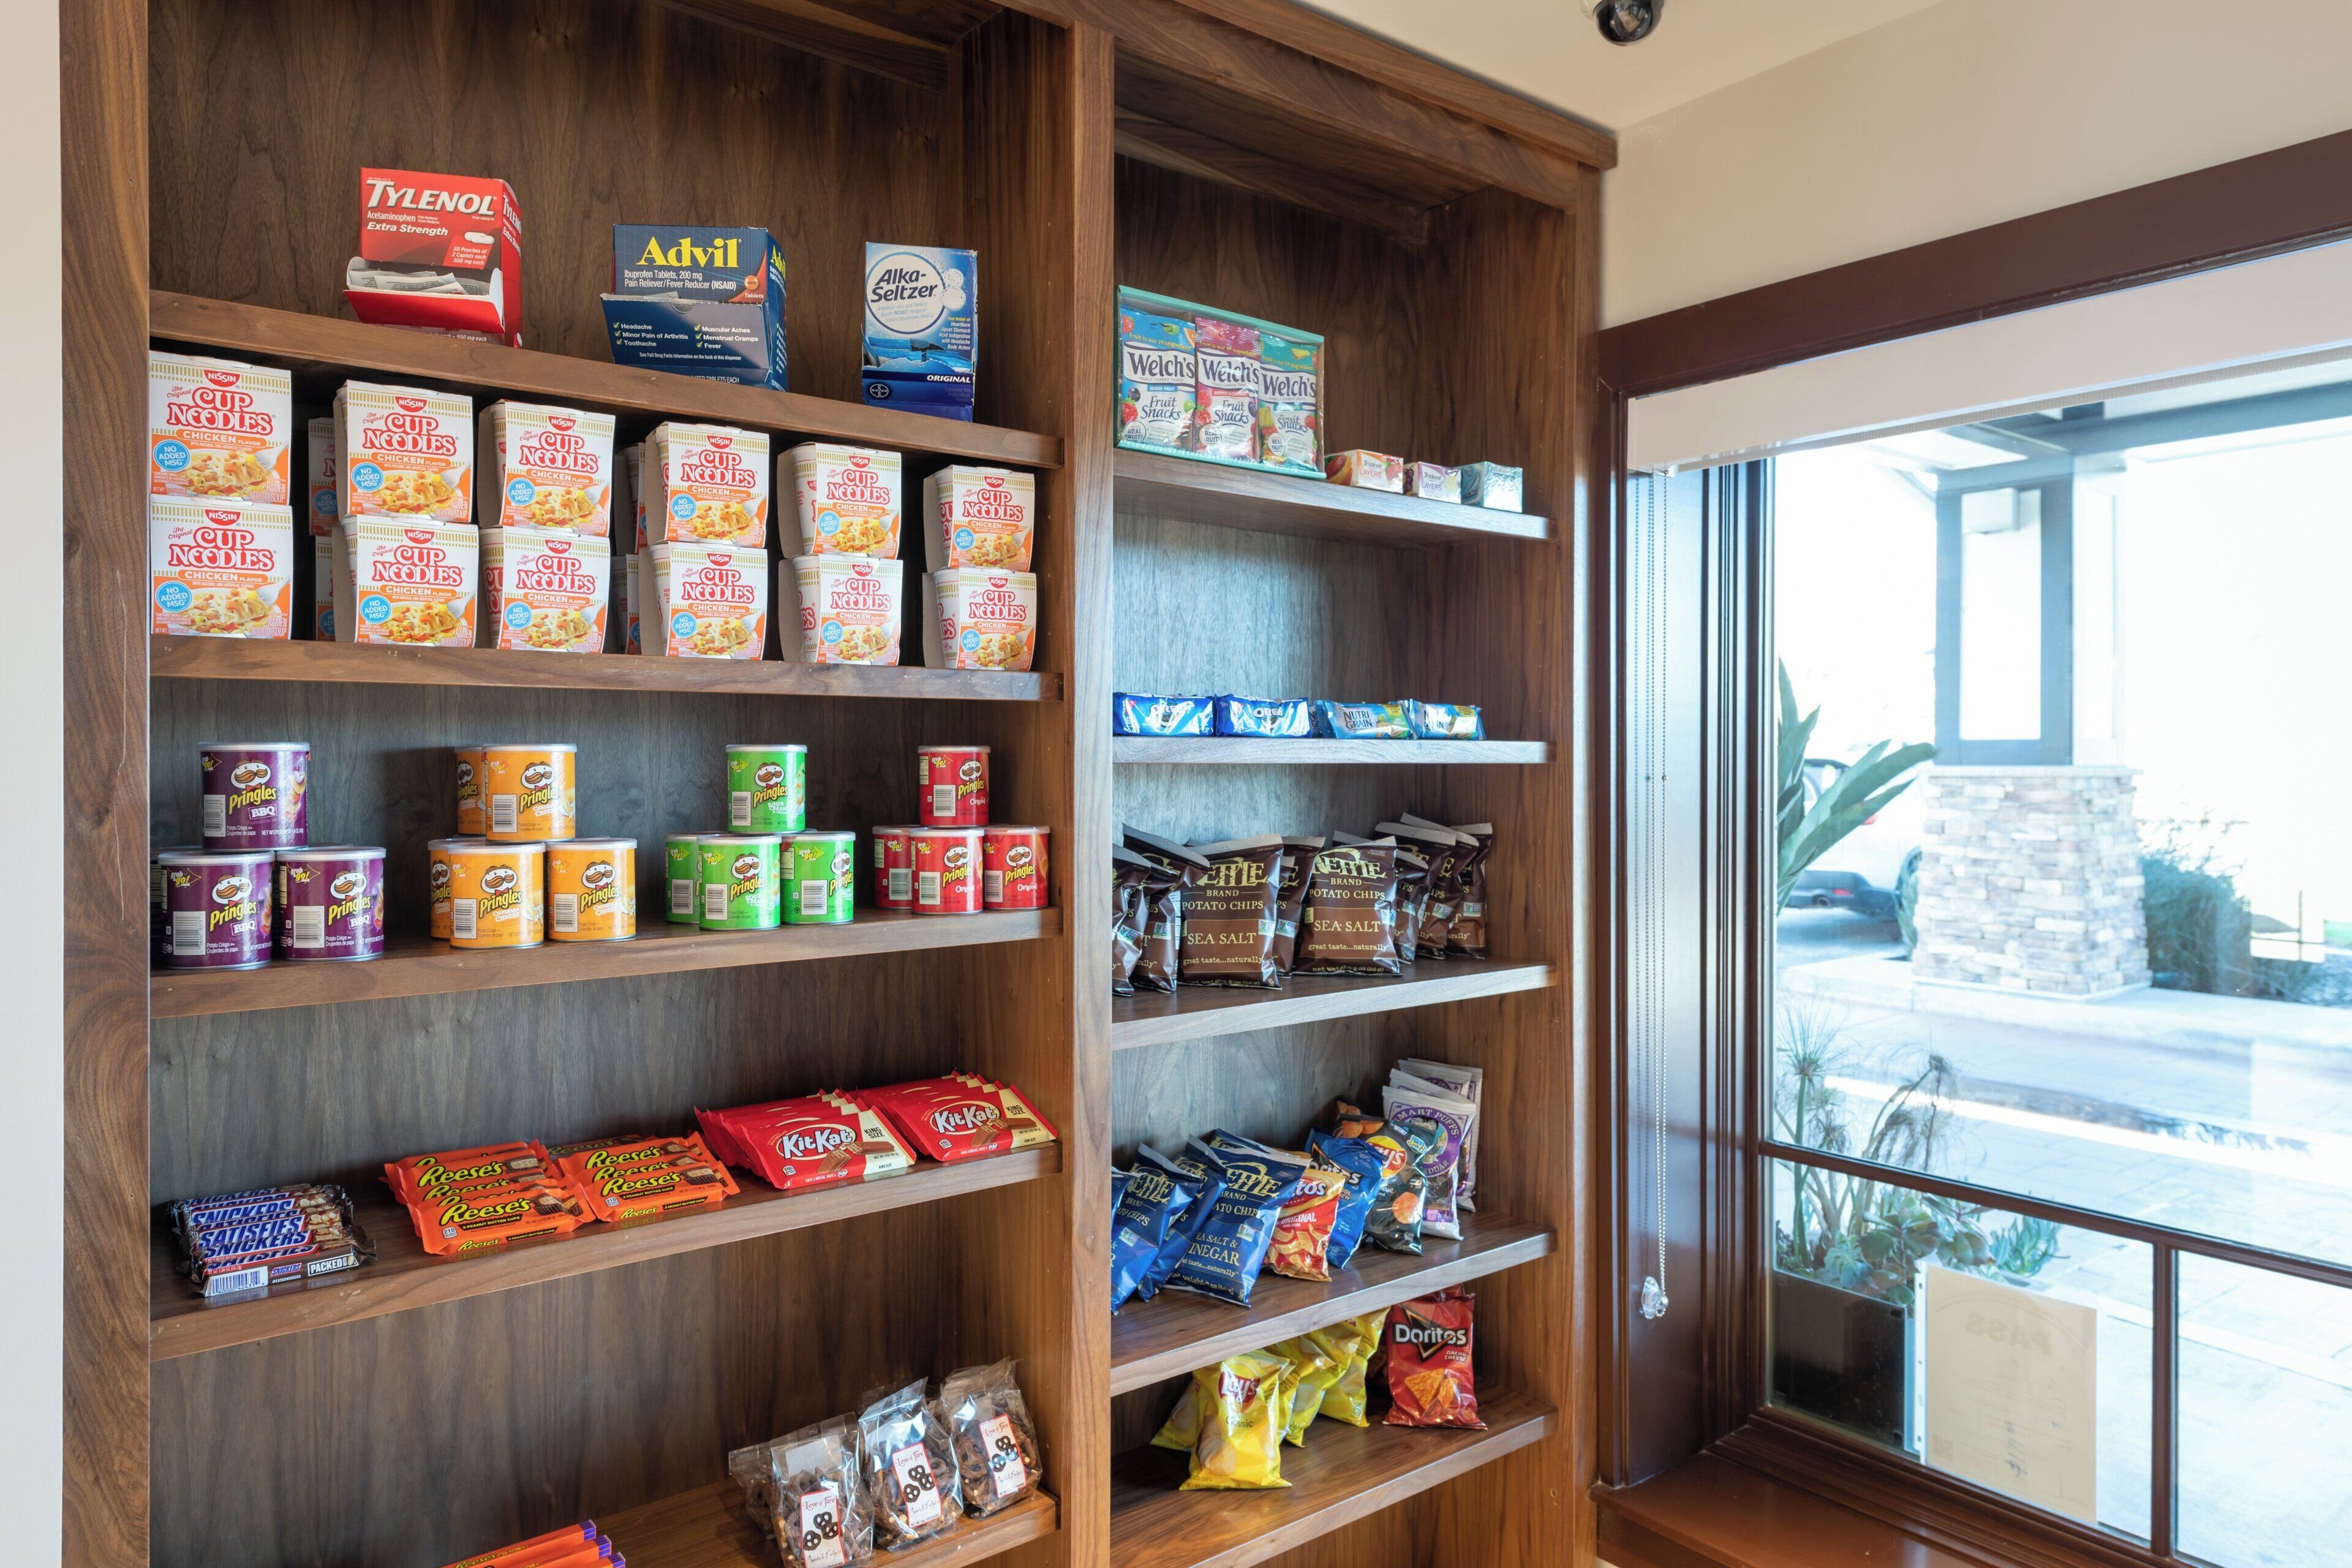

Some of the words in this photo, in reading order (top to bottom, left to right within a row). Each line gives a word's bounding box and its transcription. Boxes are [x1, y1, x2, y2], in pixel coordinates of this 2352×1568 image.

[366, 179, 494, 216] TYLENOL
[368, 211, 415, 222] Acetaminophen
[368, 222, 397, 232] Extra
[399, 224, 448, 236] Strength
[636, 236, 739, 268] Advil
[624, 270, 652, 279] Ibuprofen
[654, 270, 678, 280] Tablets,
[679, 271, 691, 279] 200
[876, 268, 926, 285] Alka-
[711, 281, 736, 290] (NSAID)
[871, 284, 937, 303] Seltzer
[1127, 352, 1195, 379] Welch's
[1200, 357, 1259, 385] Welch's
[208, 372, 236, 383] NISSIN
[1261, 373, 1316, 398] Welch's
[192, 386, 253, 412] CUP
[399, 399, 423, 408] NISSIN
[1148, 396, 1177, 408] Fruit
[167, 402, 273, 435] NOODLES
[385, 412, 439, 435] CUP
[1140, 407, 1182, 420] Snacks
[183, 431, 236, 444] CHICKEN
[363, 428, 456, 456] NOODLES
[538, 431, 586, 453] CUP
[377, 454, 424, 465] CHICKEN
[519, 445, 600, 474] NOODLES
[1363, 461, 1382, 470] Trident
[530, 470, 570, 481] CHICKEN
[1359, 470, 1382, 478] LAYERS
[1424, 472, 1441, 481] Trident
[977, 488, 1012, 506] CUP
[1422, 483, 1442, 491] LAYERS
[209, 511, 236, 521] NISSIN
[962, 501, 1023, 522] NOODLES
[194, 526, 254, 549] CUP
[408, 531, 431, 540] NISSIN
[168, 544, 274, 571] NOODLES
[394, 545, 446, 567] CUP
[184, 571, 237, 581] CHICKEN
[372, 560, 463, 587] NOODLES
[385, 586, 431, 596] CHICKEN
[1343, 710, 1370, 722] NUTRI
[1346, 718, 1373, 729] GRAIN
[753, 786, 788, 809] Pringles
[958, 778, 984, 800] Pringles
[228, 785, 277, 815] Pringles
[519, 786, 559, 813] Pringles
[251, 806, 276, 818] BBQ
[942, 865, 974, 888] Pringles
[1005, 864, 1035, 886] Pringles
[1196, 858, 1269, 887] ETTLE
[730, 875, 765, 902] Pringles
[1309, 889, 1350, 899] POTATO
[1354, 891, 1385, 900] CHIPS
[479, 890, 522, 919] Pringles
[580, 885, 619, 913] Pringles
[1182, 902, 1226, 910] POTATO
[1230, 900, 1264, 910] CHIPS
[209, 900, 257, 932] Pringles
[328, 895, 371, 925] Pringles
[1314, 921, 1341, 932] SEA
[1346, 921, 1381, 932] SALT
[1188, 933, 1215, 944] SEA
[1219, 933, 1257, 943] SALT
[586, 1147, 661, 1169] Reese's
[418, 1162, 503, 1188] Reese's
[601, 1172, 681, 1197] Reese's
[439, 1199, 532, 1226] Reese's
[619, 1207, 657, 1219] Reese's
[1281, 1213, 1316, 1224] ORIGINAL
[200, 1216, 302, 1248] SATISFIES
[1206, 1234, 1227, 1246] SALT
[1231, 1240, 1238, 1248] &
[205, 1231, 307, 1258] SNICKERS
[458, 1238, 500, 1252] Reese's
[1188, 1242, 1240, 1266] INEGAR
[271, 1263, 301, 1275] SNICKERS
[310, 1259, 342, 1274] PACKED
[1395, 1324, 1466, 1344] Doritos
[1220, 1375, 1261, 1403] Lay's
